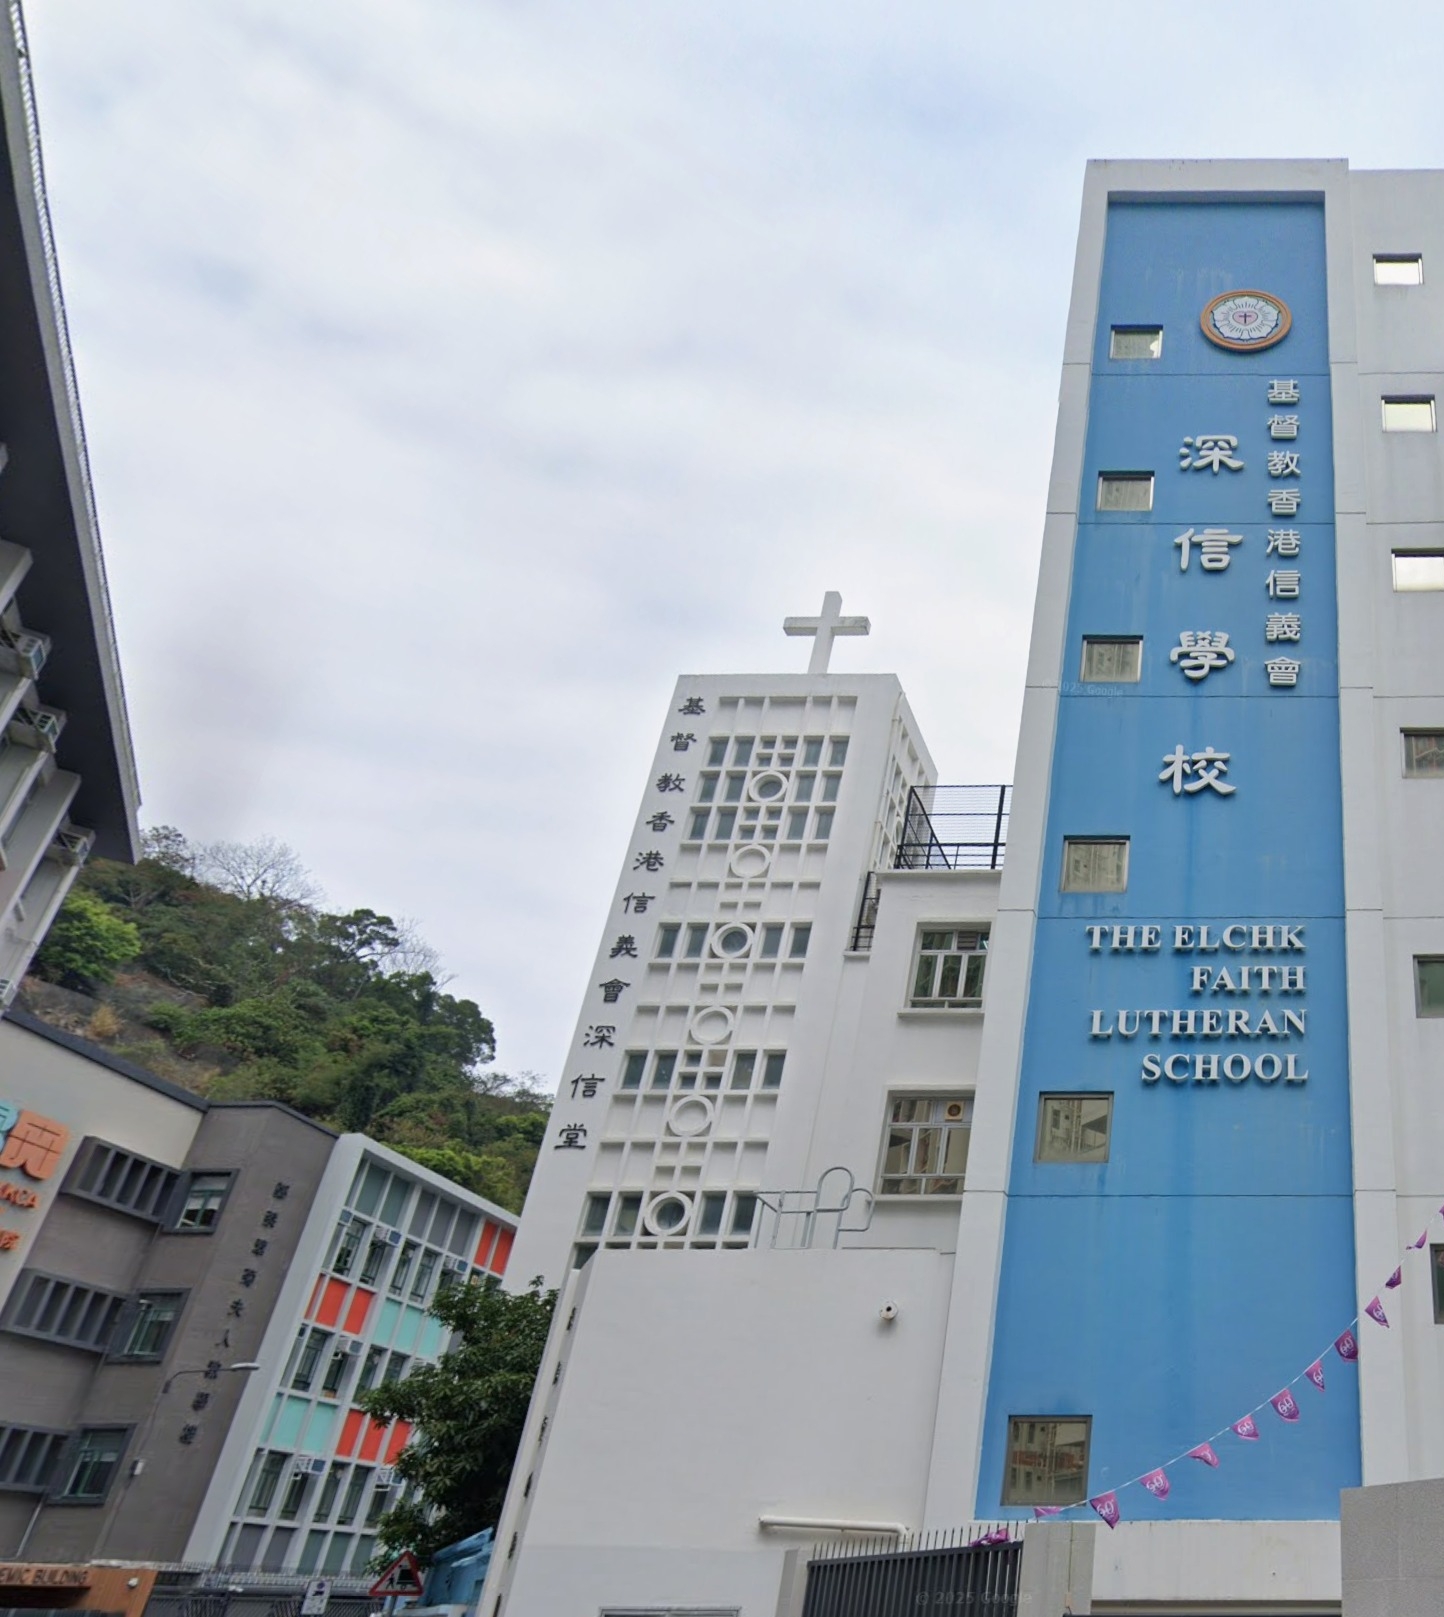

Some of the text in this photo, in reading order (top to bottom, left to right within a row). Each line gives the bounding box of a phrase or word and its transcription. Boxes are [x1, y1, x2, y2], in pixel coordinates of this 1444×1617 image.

[1264, 379, 1301, 687] 基督教香港信義會
[1158, 434, 1245, 796] 深信學校
[554, 696, 706, 1151] 基督教香港信義會深信堂
[1086, 924, 1307, 950] THE ELCHK
[1190, 965, 1307, 991] FAITH
[1089, 1008, 1308, 1036] LUTHERAN
[1140, 1053, 1310, 1082] SCHOOL
